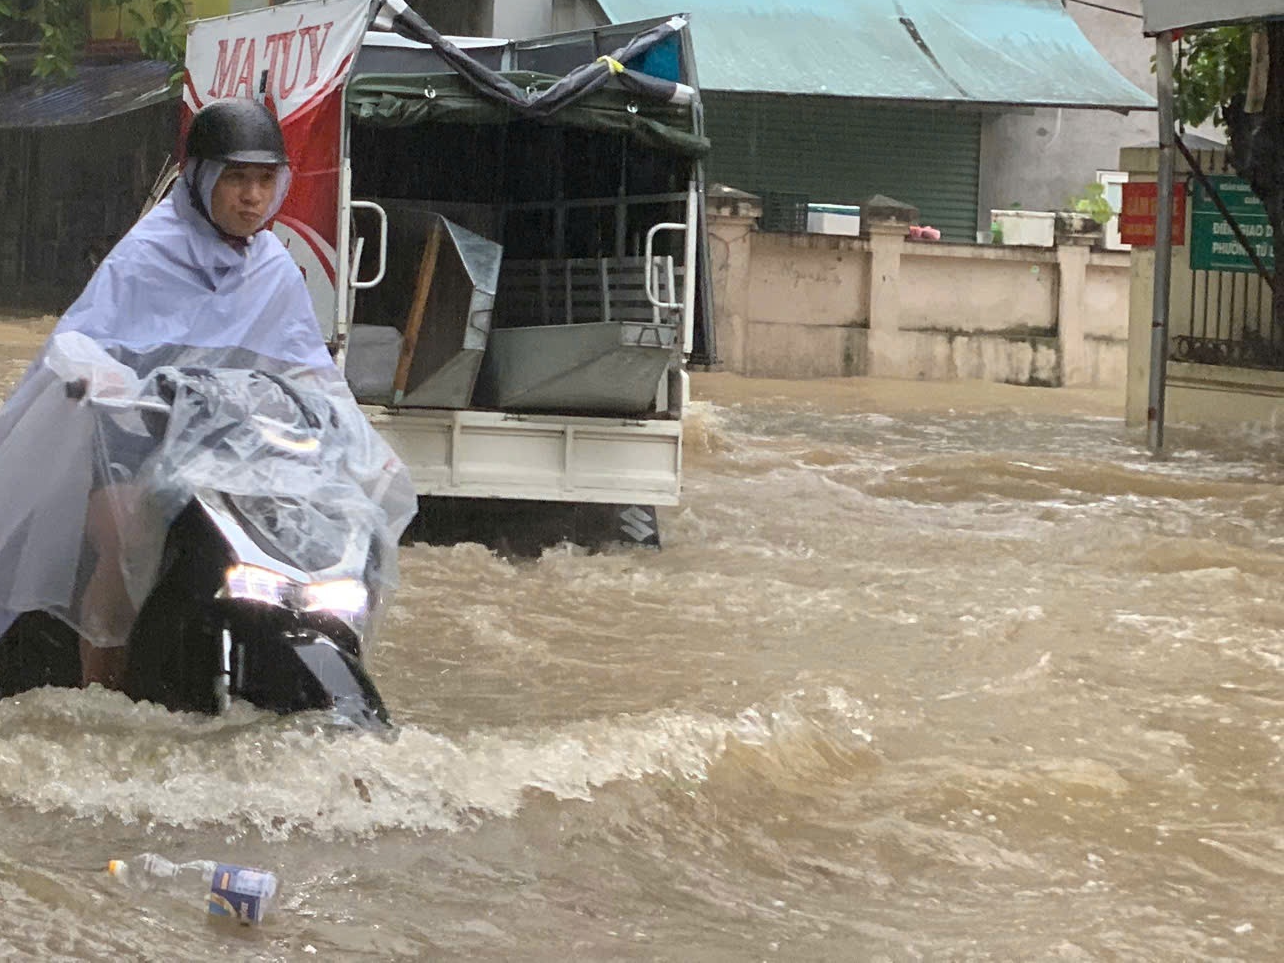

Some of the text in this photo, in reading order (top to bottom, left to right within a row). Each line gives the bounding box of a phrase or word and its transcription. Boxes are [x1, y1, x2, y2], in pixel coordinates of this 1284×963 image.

[208, 14, 334, 100] MA TÚY
[1212, 239, 1250, 257] PHƯỜN
